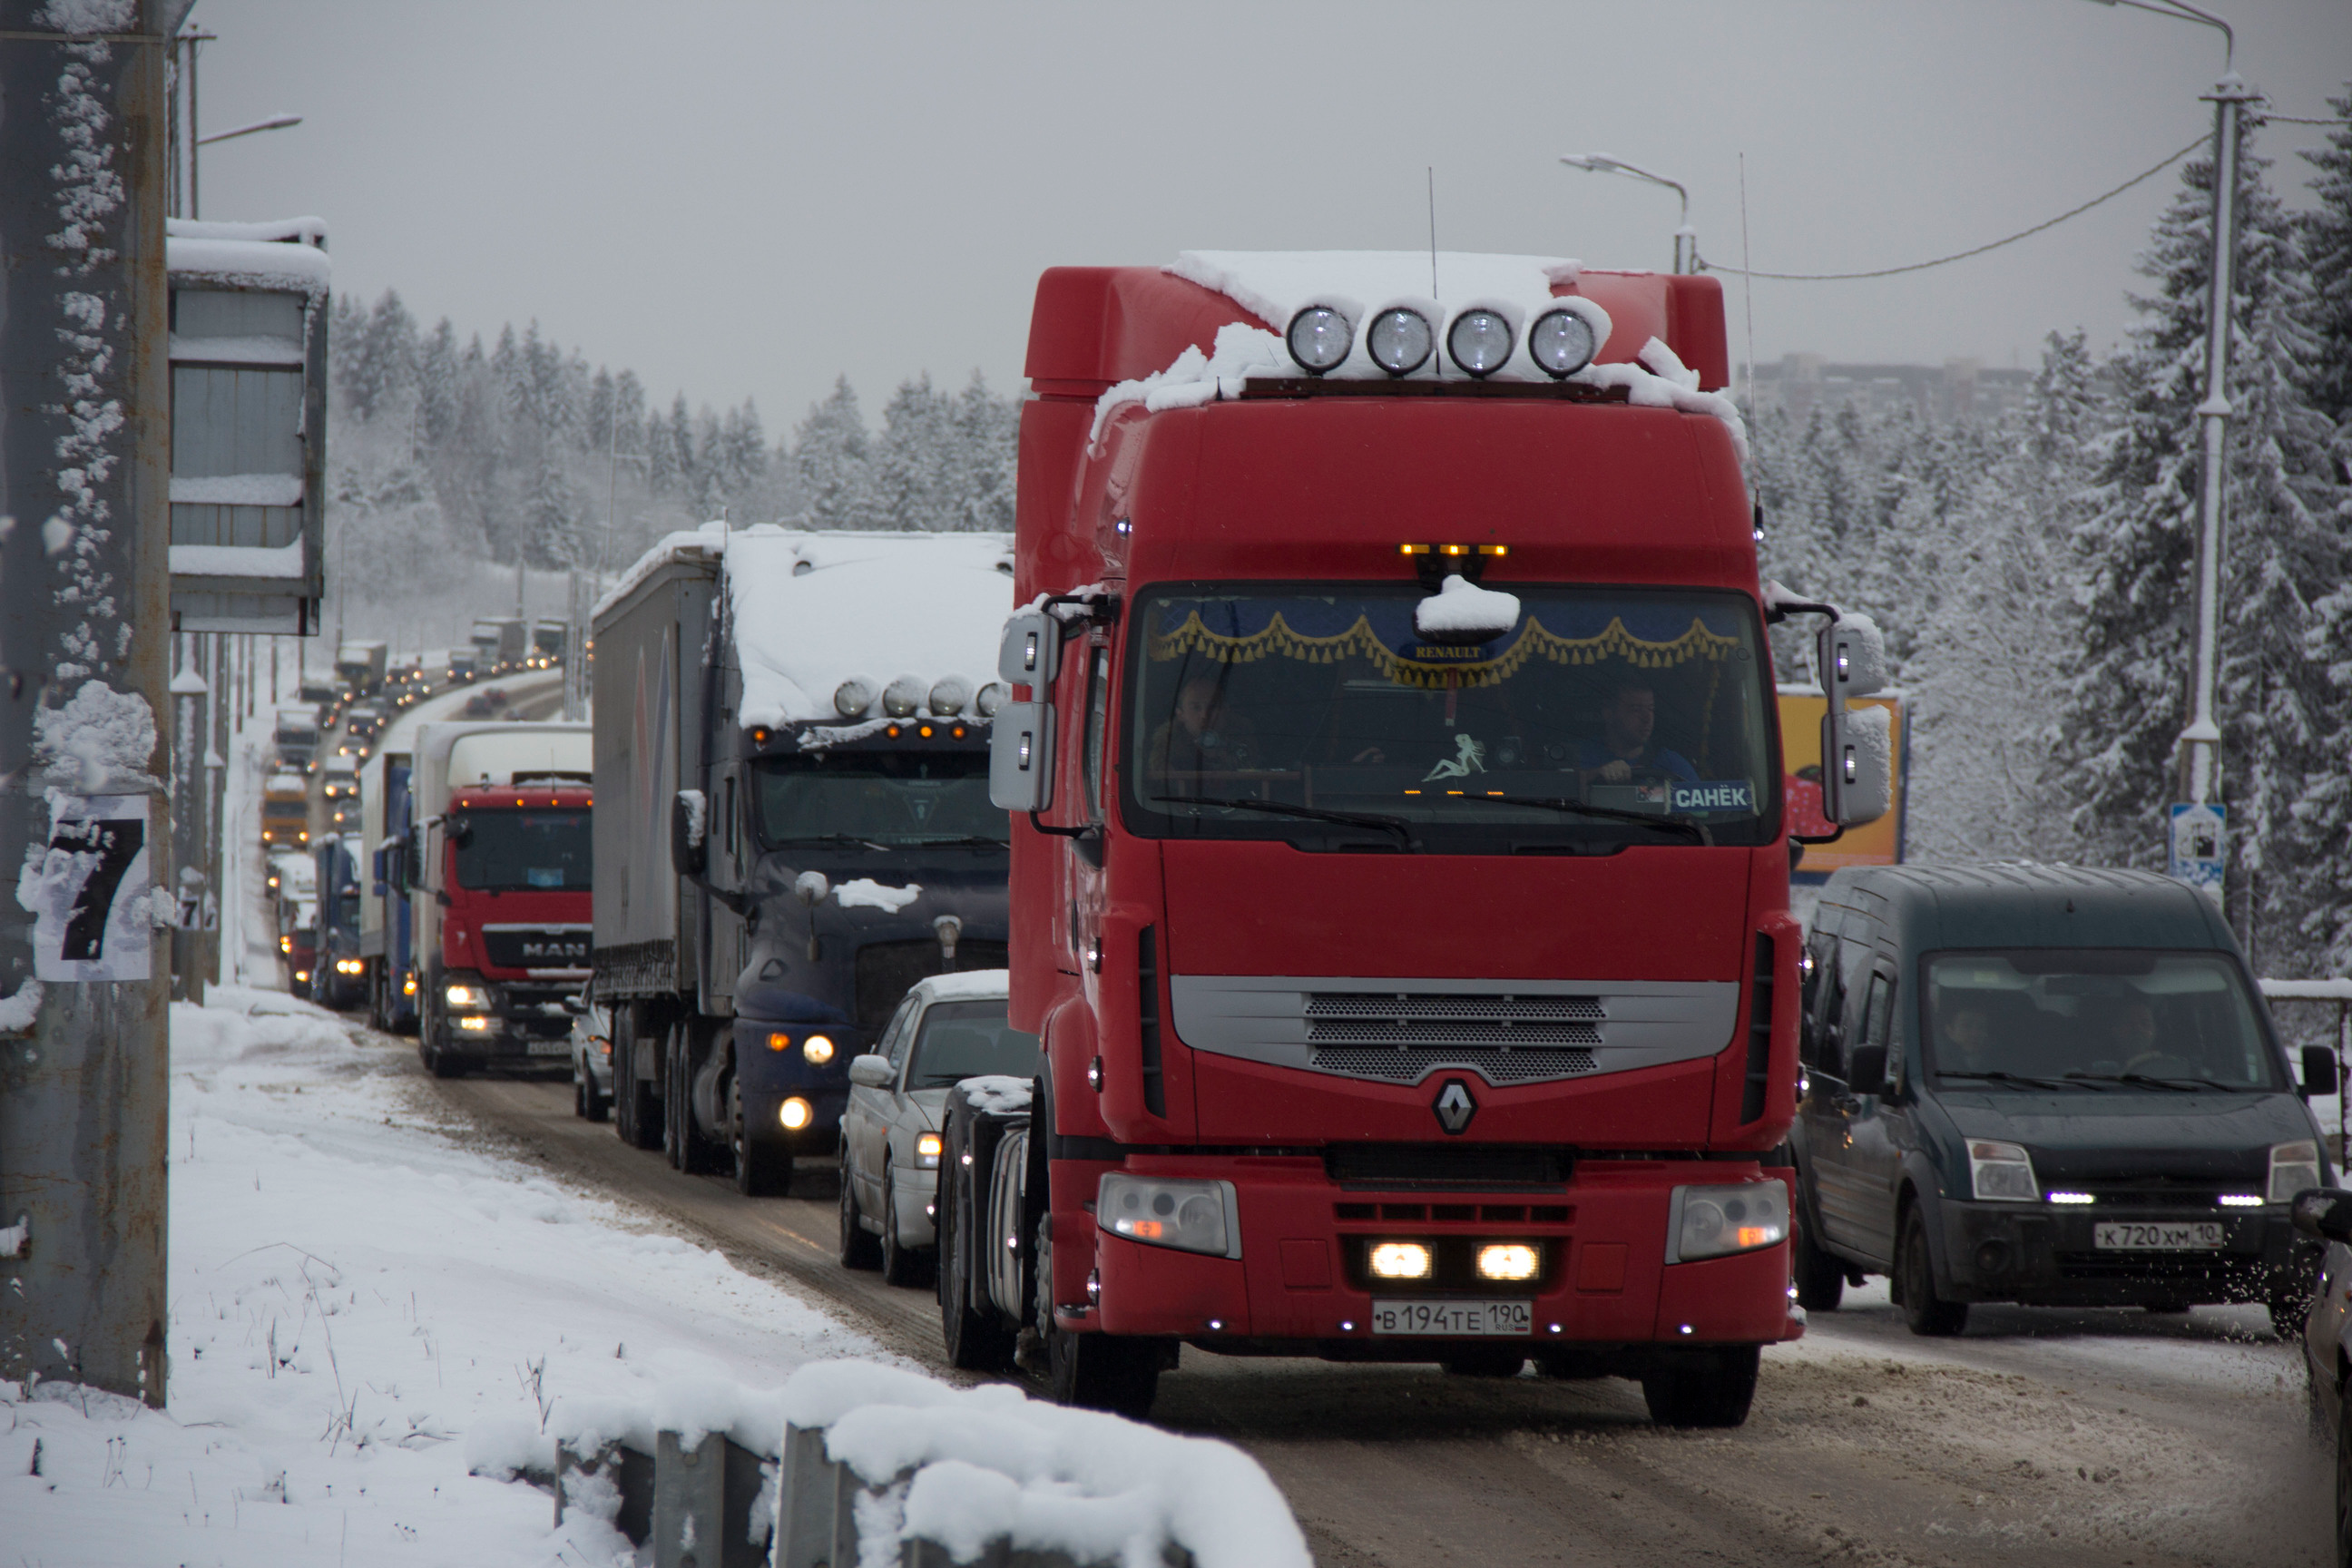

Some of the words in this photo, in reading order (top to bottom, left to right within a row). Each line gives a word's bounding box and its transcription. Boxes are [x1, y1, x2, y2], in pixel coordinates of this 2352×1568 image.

[1416, 646, 1481, 658] RENAULT
[1675, 784, 1748, 808] САНЁК
[48, 818, 144, 961] 7
[181, 899, 198, 926] 7
[522, 942, 586, 956] MAN
[1382, 1305, 1481, 1331] В194ТЕ
[1487, 1304, 1524, 1324] 190
[1494, 1324, 1514, 1332] RUS
